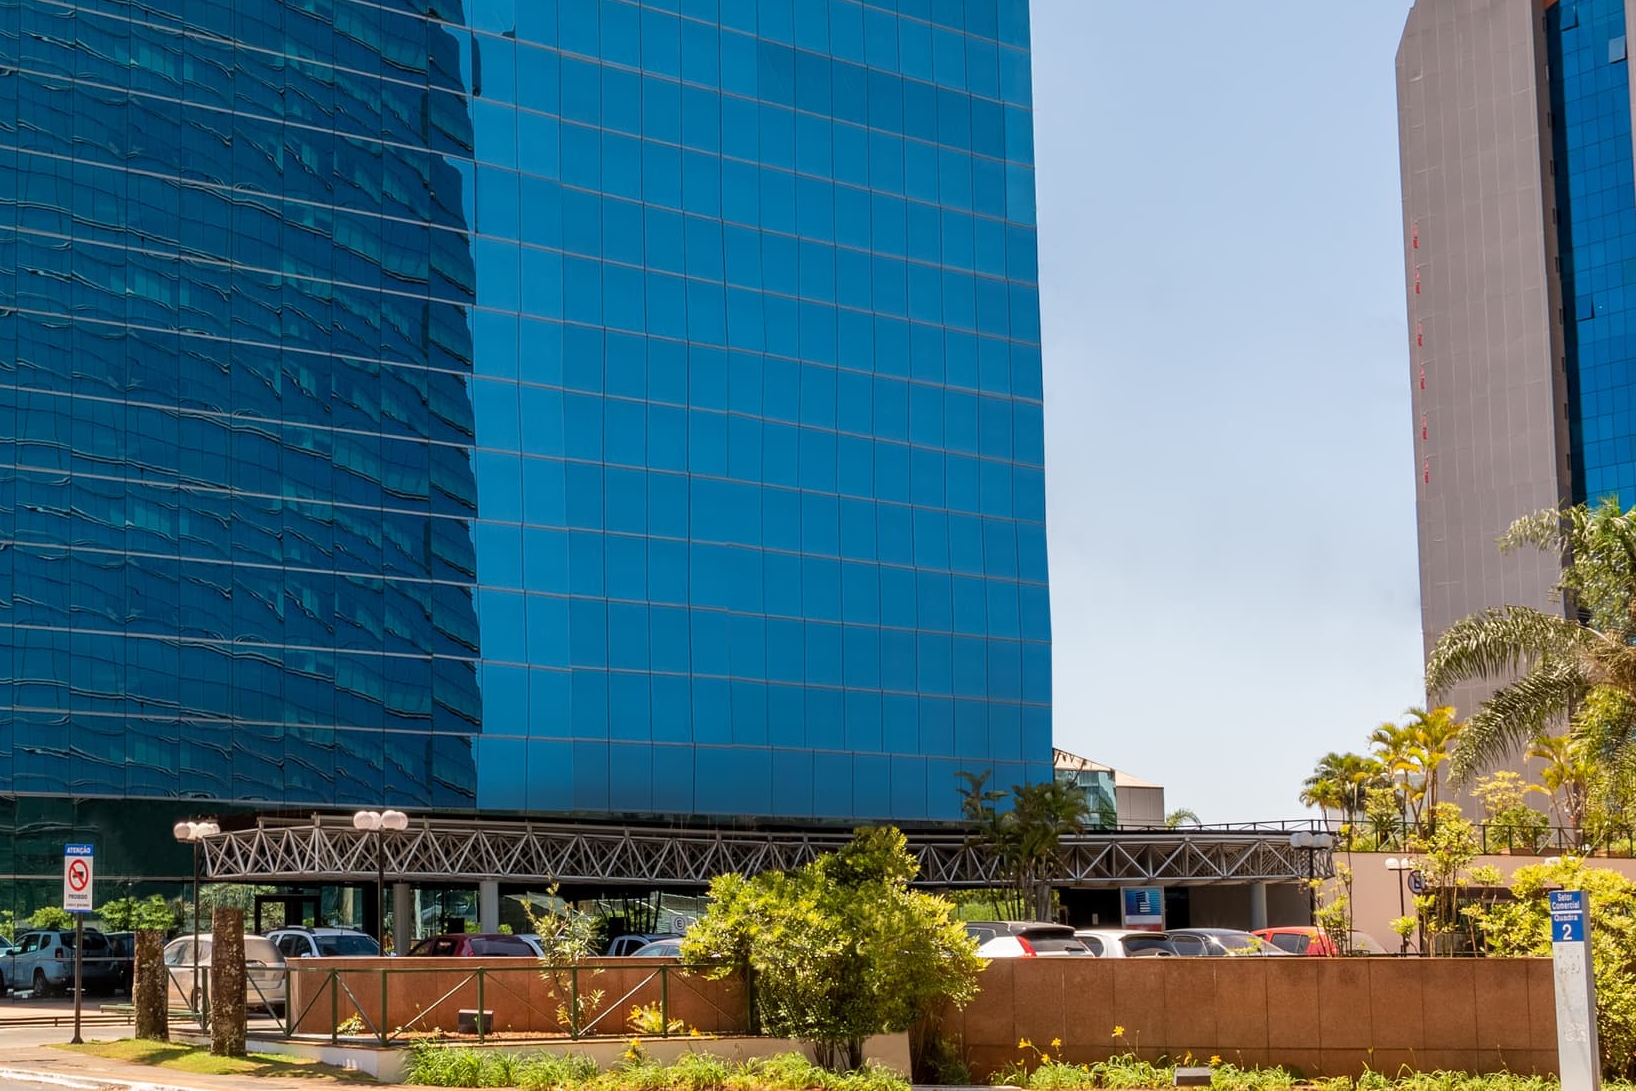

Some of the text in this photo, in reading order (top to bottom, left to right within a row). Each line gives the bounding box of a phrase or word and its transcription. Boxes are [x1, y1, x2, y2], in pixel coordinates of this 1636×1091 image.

[66, 845, 91, 855] ATENÇÃO
[1557, 893, 1573, 902] Setor
[1552, 900, 1581, 910] Comercial
[1554, 914, 1578, 922] Quadra
[1562, 923, 1573, 940] 2
